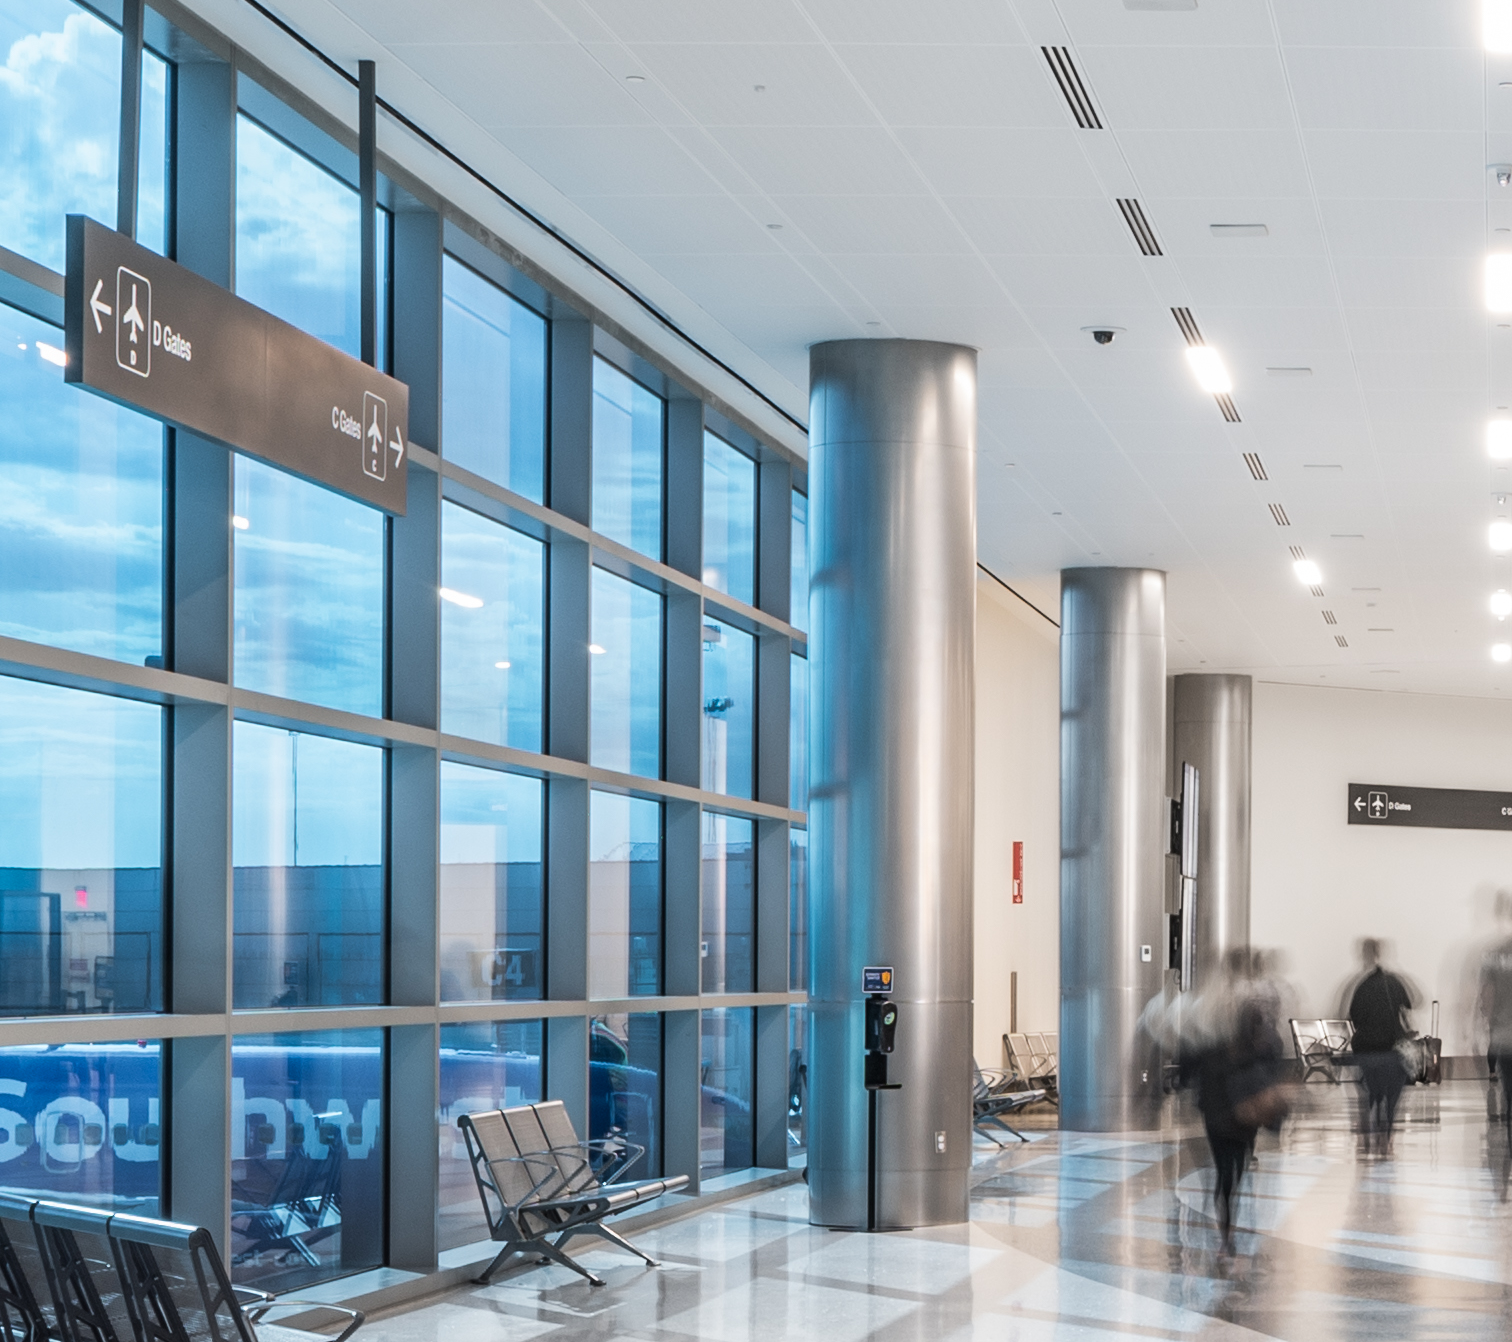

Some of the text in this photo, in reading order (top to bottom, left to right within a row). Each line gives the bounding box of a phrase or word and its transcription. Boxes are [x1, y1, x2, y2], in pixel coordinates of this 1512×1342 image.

[130, 349, 137, 366] D
[152, 320, 192, 362] D Gates
[331, 406, 362, 440] C Gates
[481, 952, 524, 987] C4
